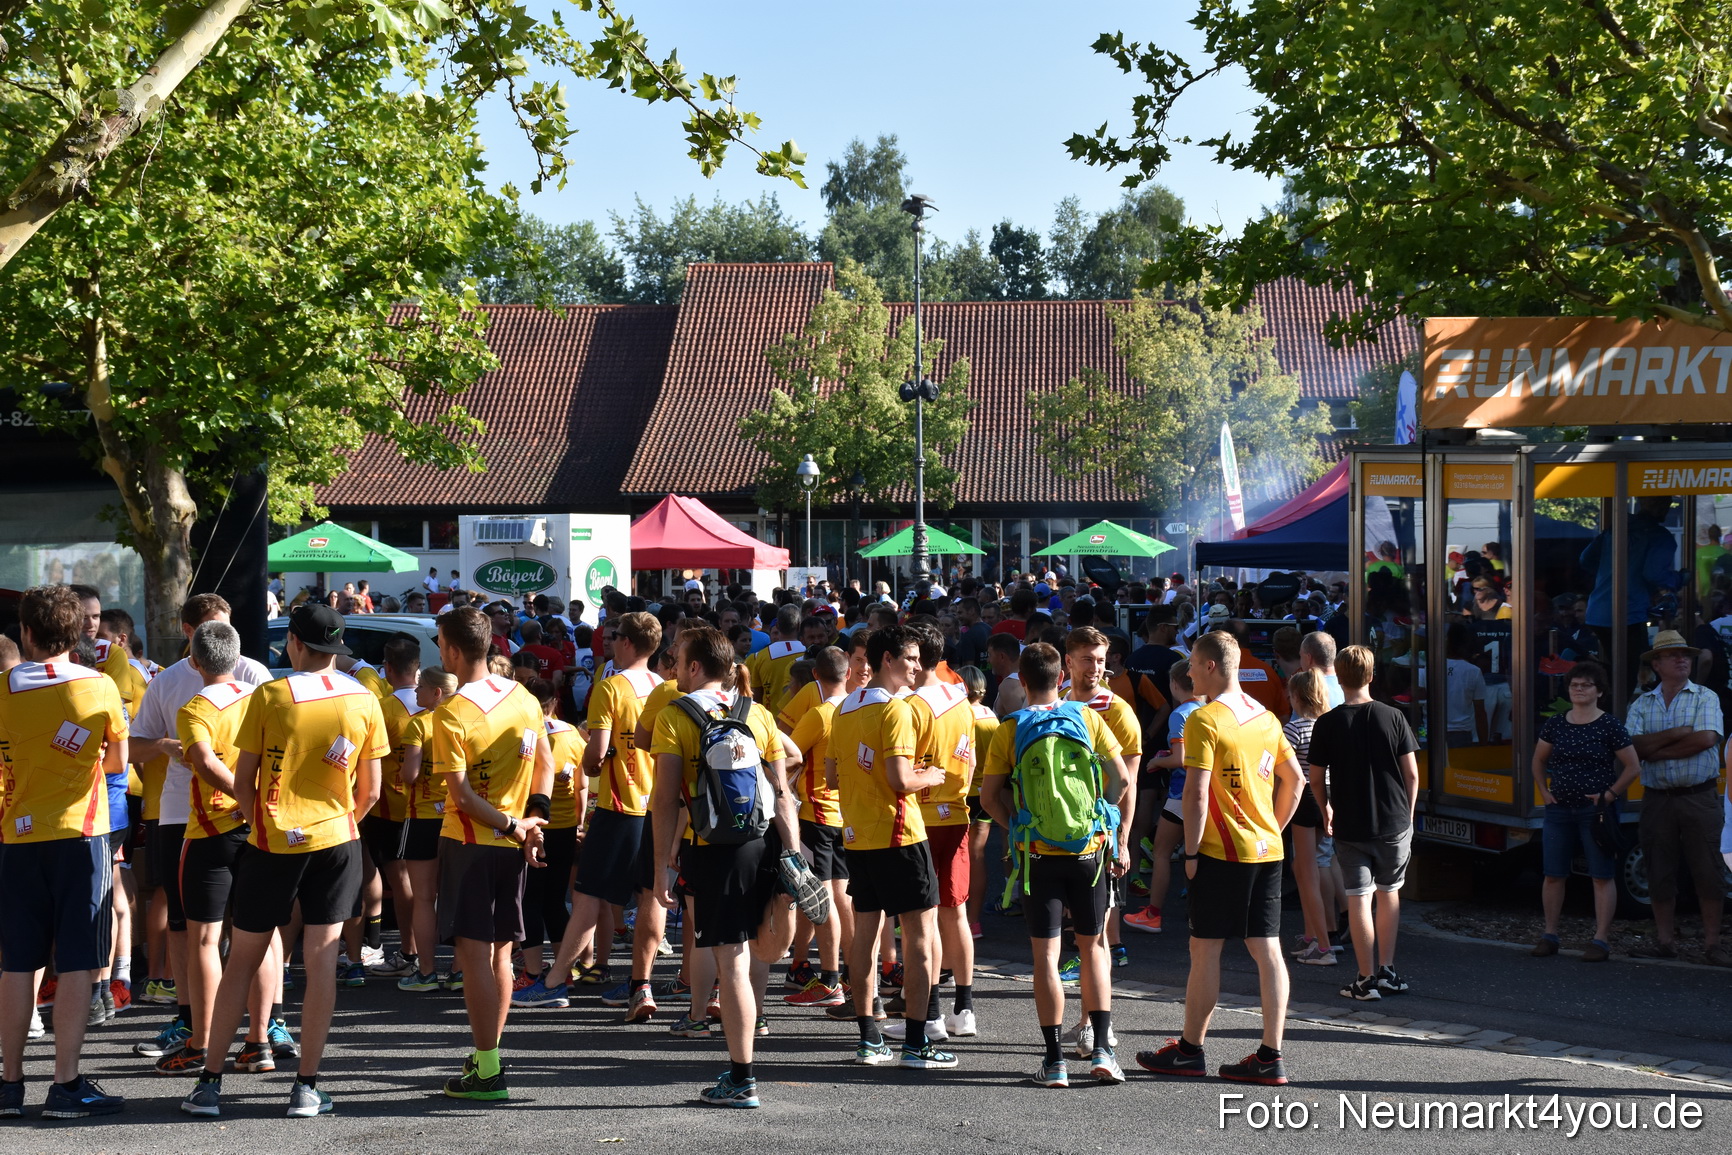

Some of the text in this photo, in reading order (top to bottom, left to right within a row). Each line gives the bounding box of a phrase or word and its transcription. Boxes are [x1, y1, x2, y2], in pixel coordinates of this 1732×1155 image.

[1435, 346, 1732, 399] RUNMARKT
[1171, 523, 1184, 532] WC
[486, 565, 545, 588] Bögerl
[1425, 817, 1439, 832] NM
[1456, 823, 1468, 838] 89
